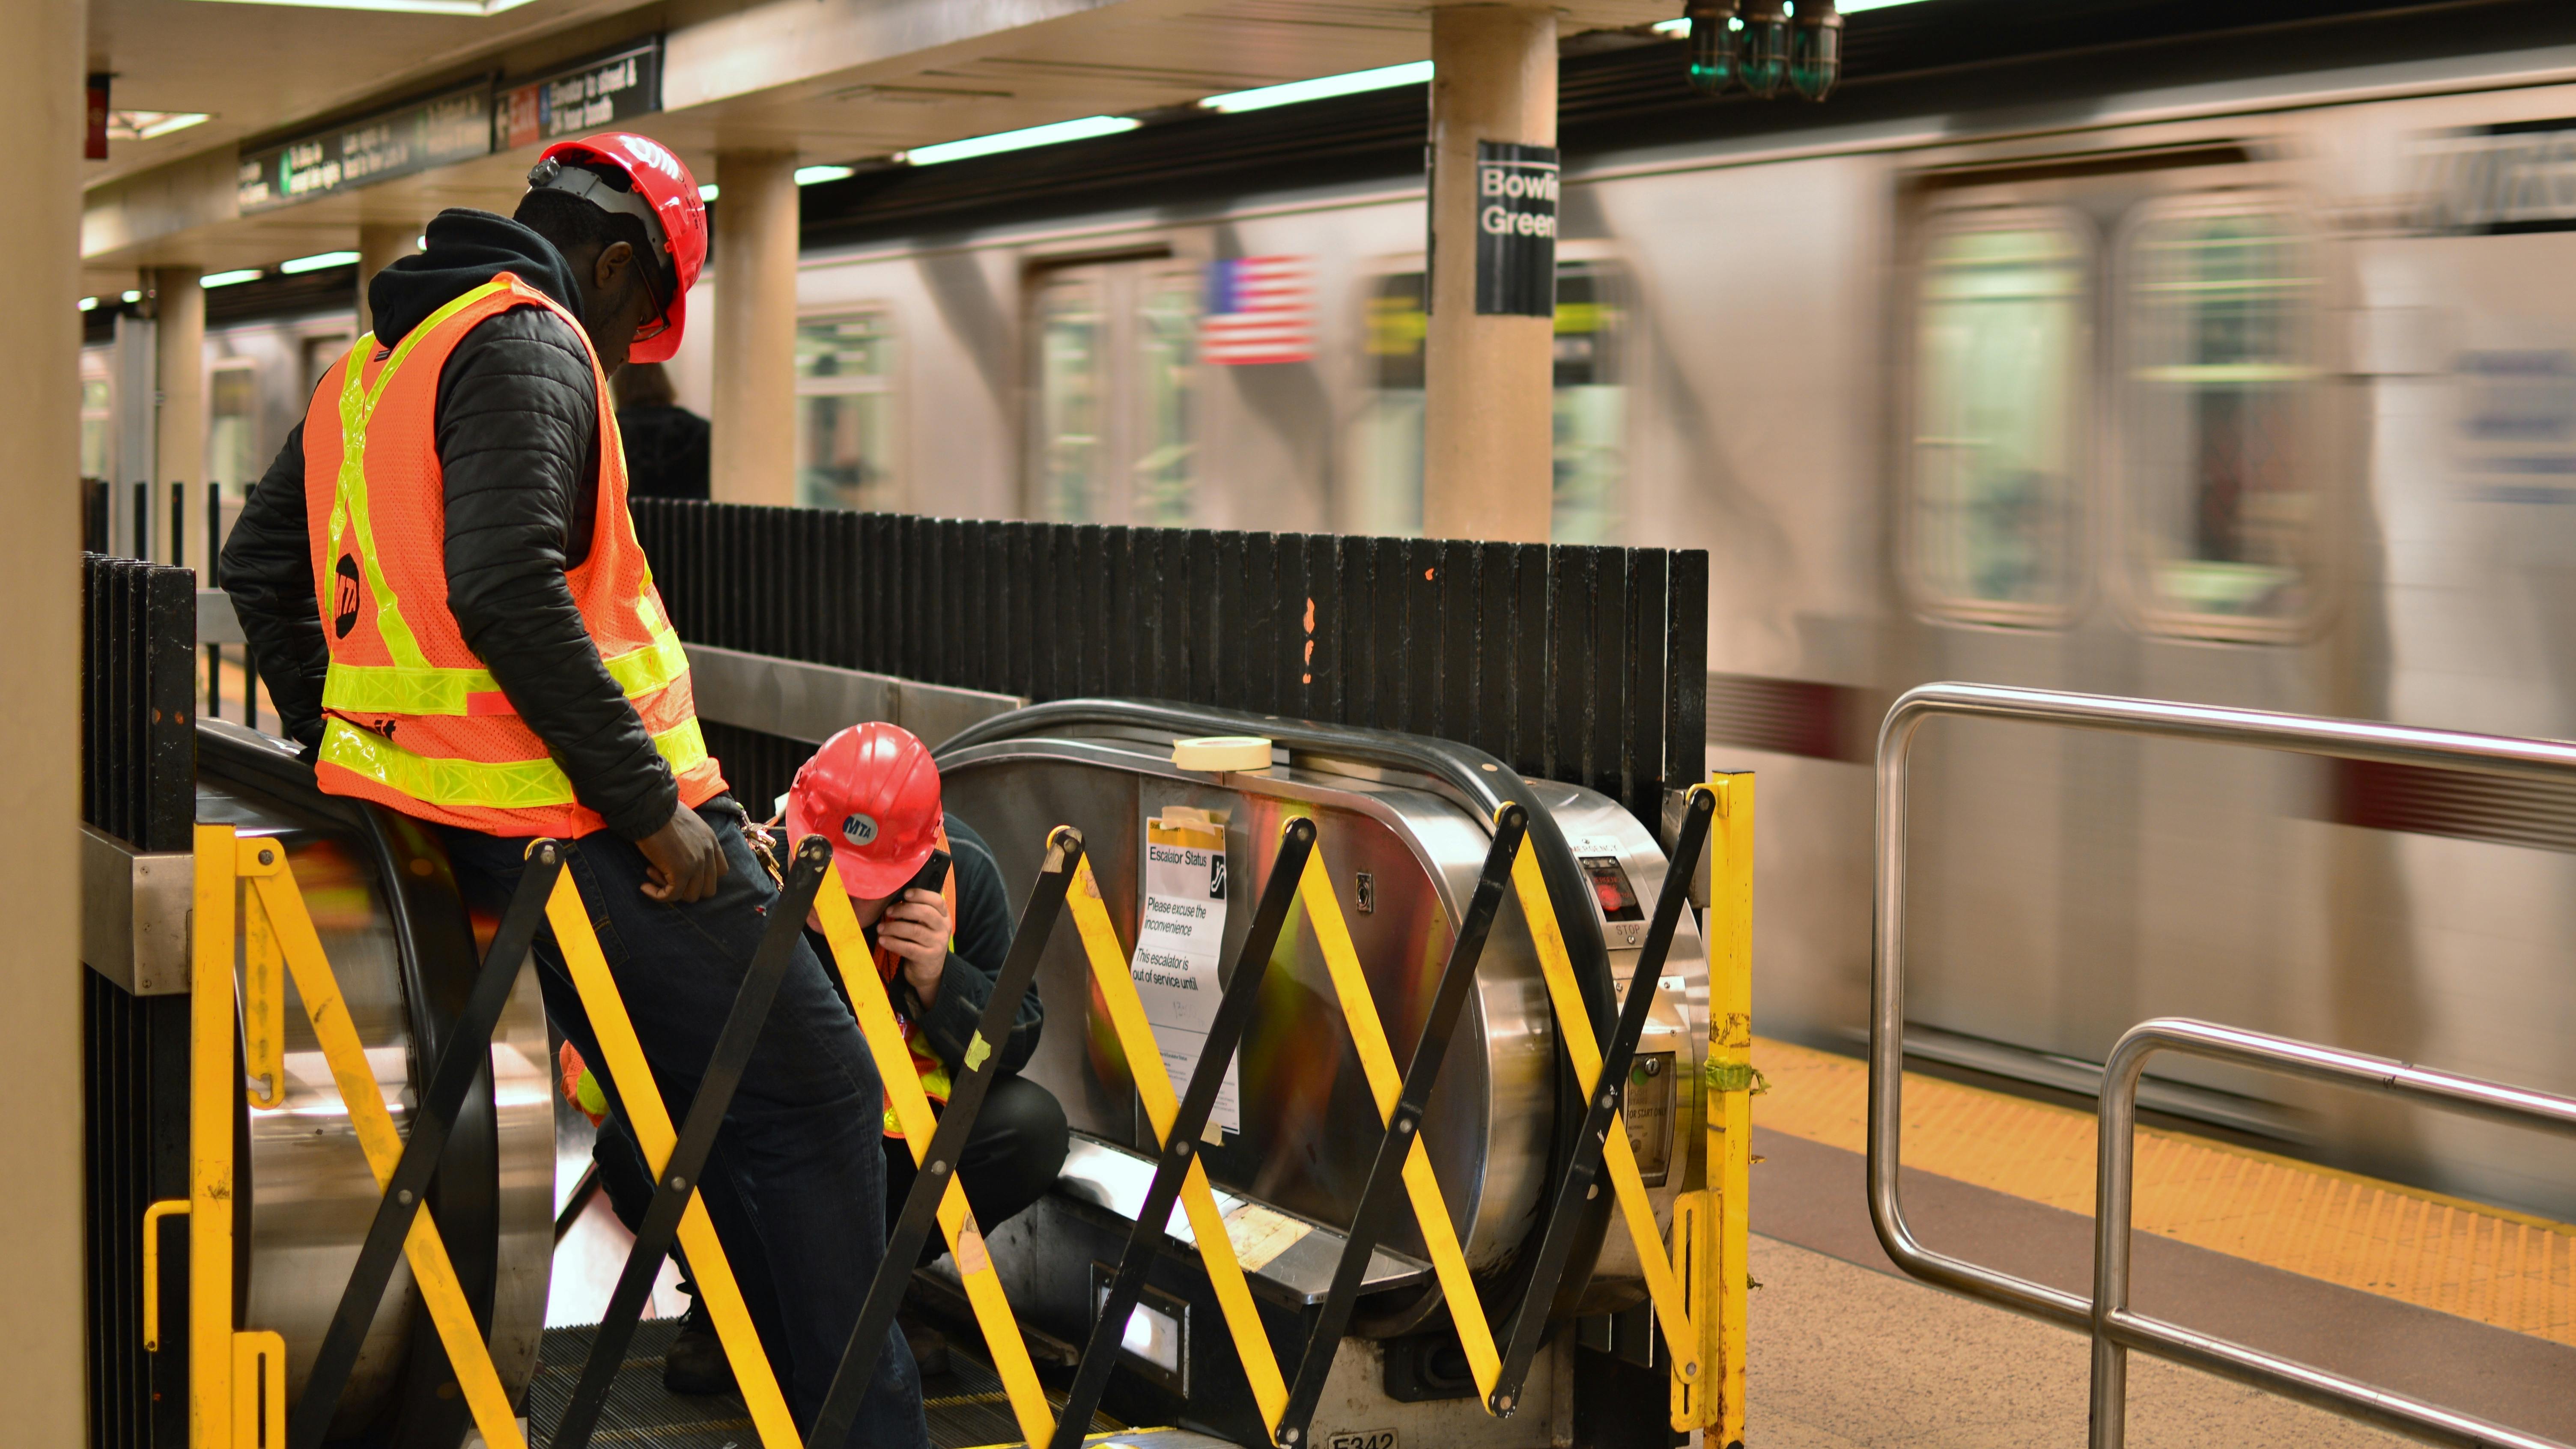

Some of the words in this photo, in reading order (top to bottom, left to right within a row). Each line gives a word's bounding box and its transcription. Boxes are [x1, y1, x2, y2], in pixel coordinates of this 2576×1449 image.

[1482, 205, 1556, 237] Green
[843, 815, 871, 839] MTA
[1150, 847, 1184, 864] Escalator
[1185, 850, 1207, 867] Status
[1147, 896, 1171, 913] Please
[1172, 904, 1195, 917] excuse
[1196, 903, 1206, 919] the
[1144, 915, 1192, 936] inconvenience
[1616, 924, 1640, 936] STOP
[1136, 948, 1150, 963] This
[1151, 953, 1182, 969] escalator
[1182, 956, 1189, 971] is
[1133, 969, 1144, 981] out
[1145, 969, 1153, 983] of
[1153, 972, 1180, 988] service
[1181, 976, 1198, 990] until
[1638, 1108, 1653, 1118] START
[1654, 1107, 1667, 1117] ONLY
